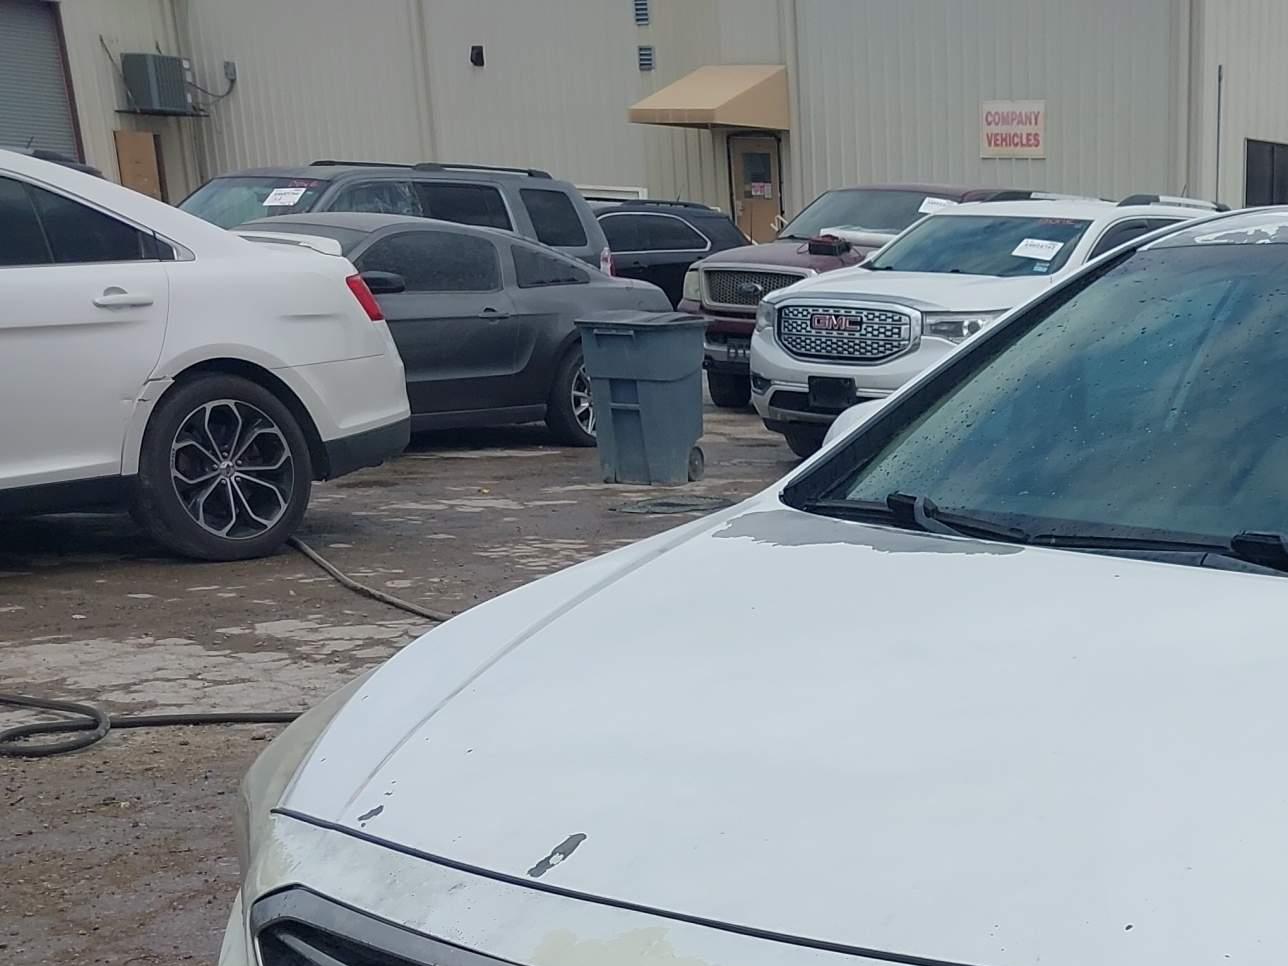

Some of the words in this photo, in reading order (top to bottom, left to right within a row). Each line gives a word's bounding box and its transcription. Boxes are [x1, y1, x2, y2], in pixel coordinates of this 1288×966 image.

[985, 111, 1041, 126] COMPANY
[986, 132, 1041, 148] VEHICLES
[811, 314, 862, 330] GMC
